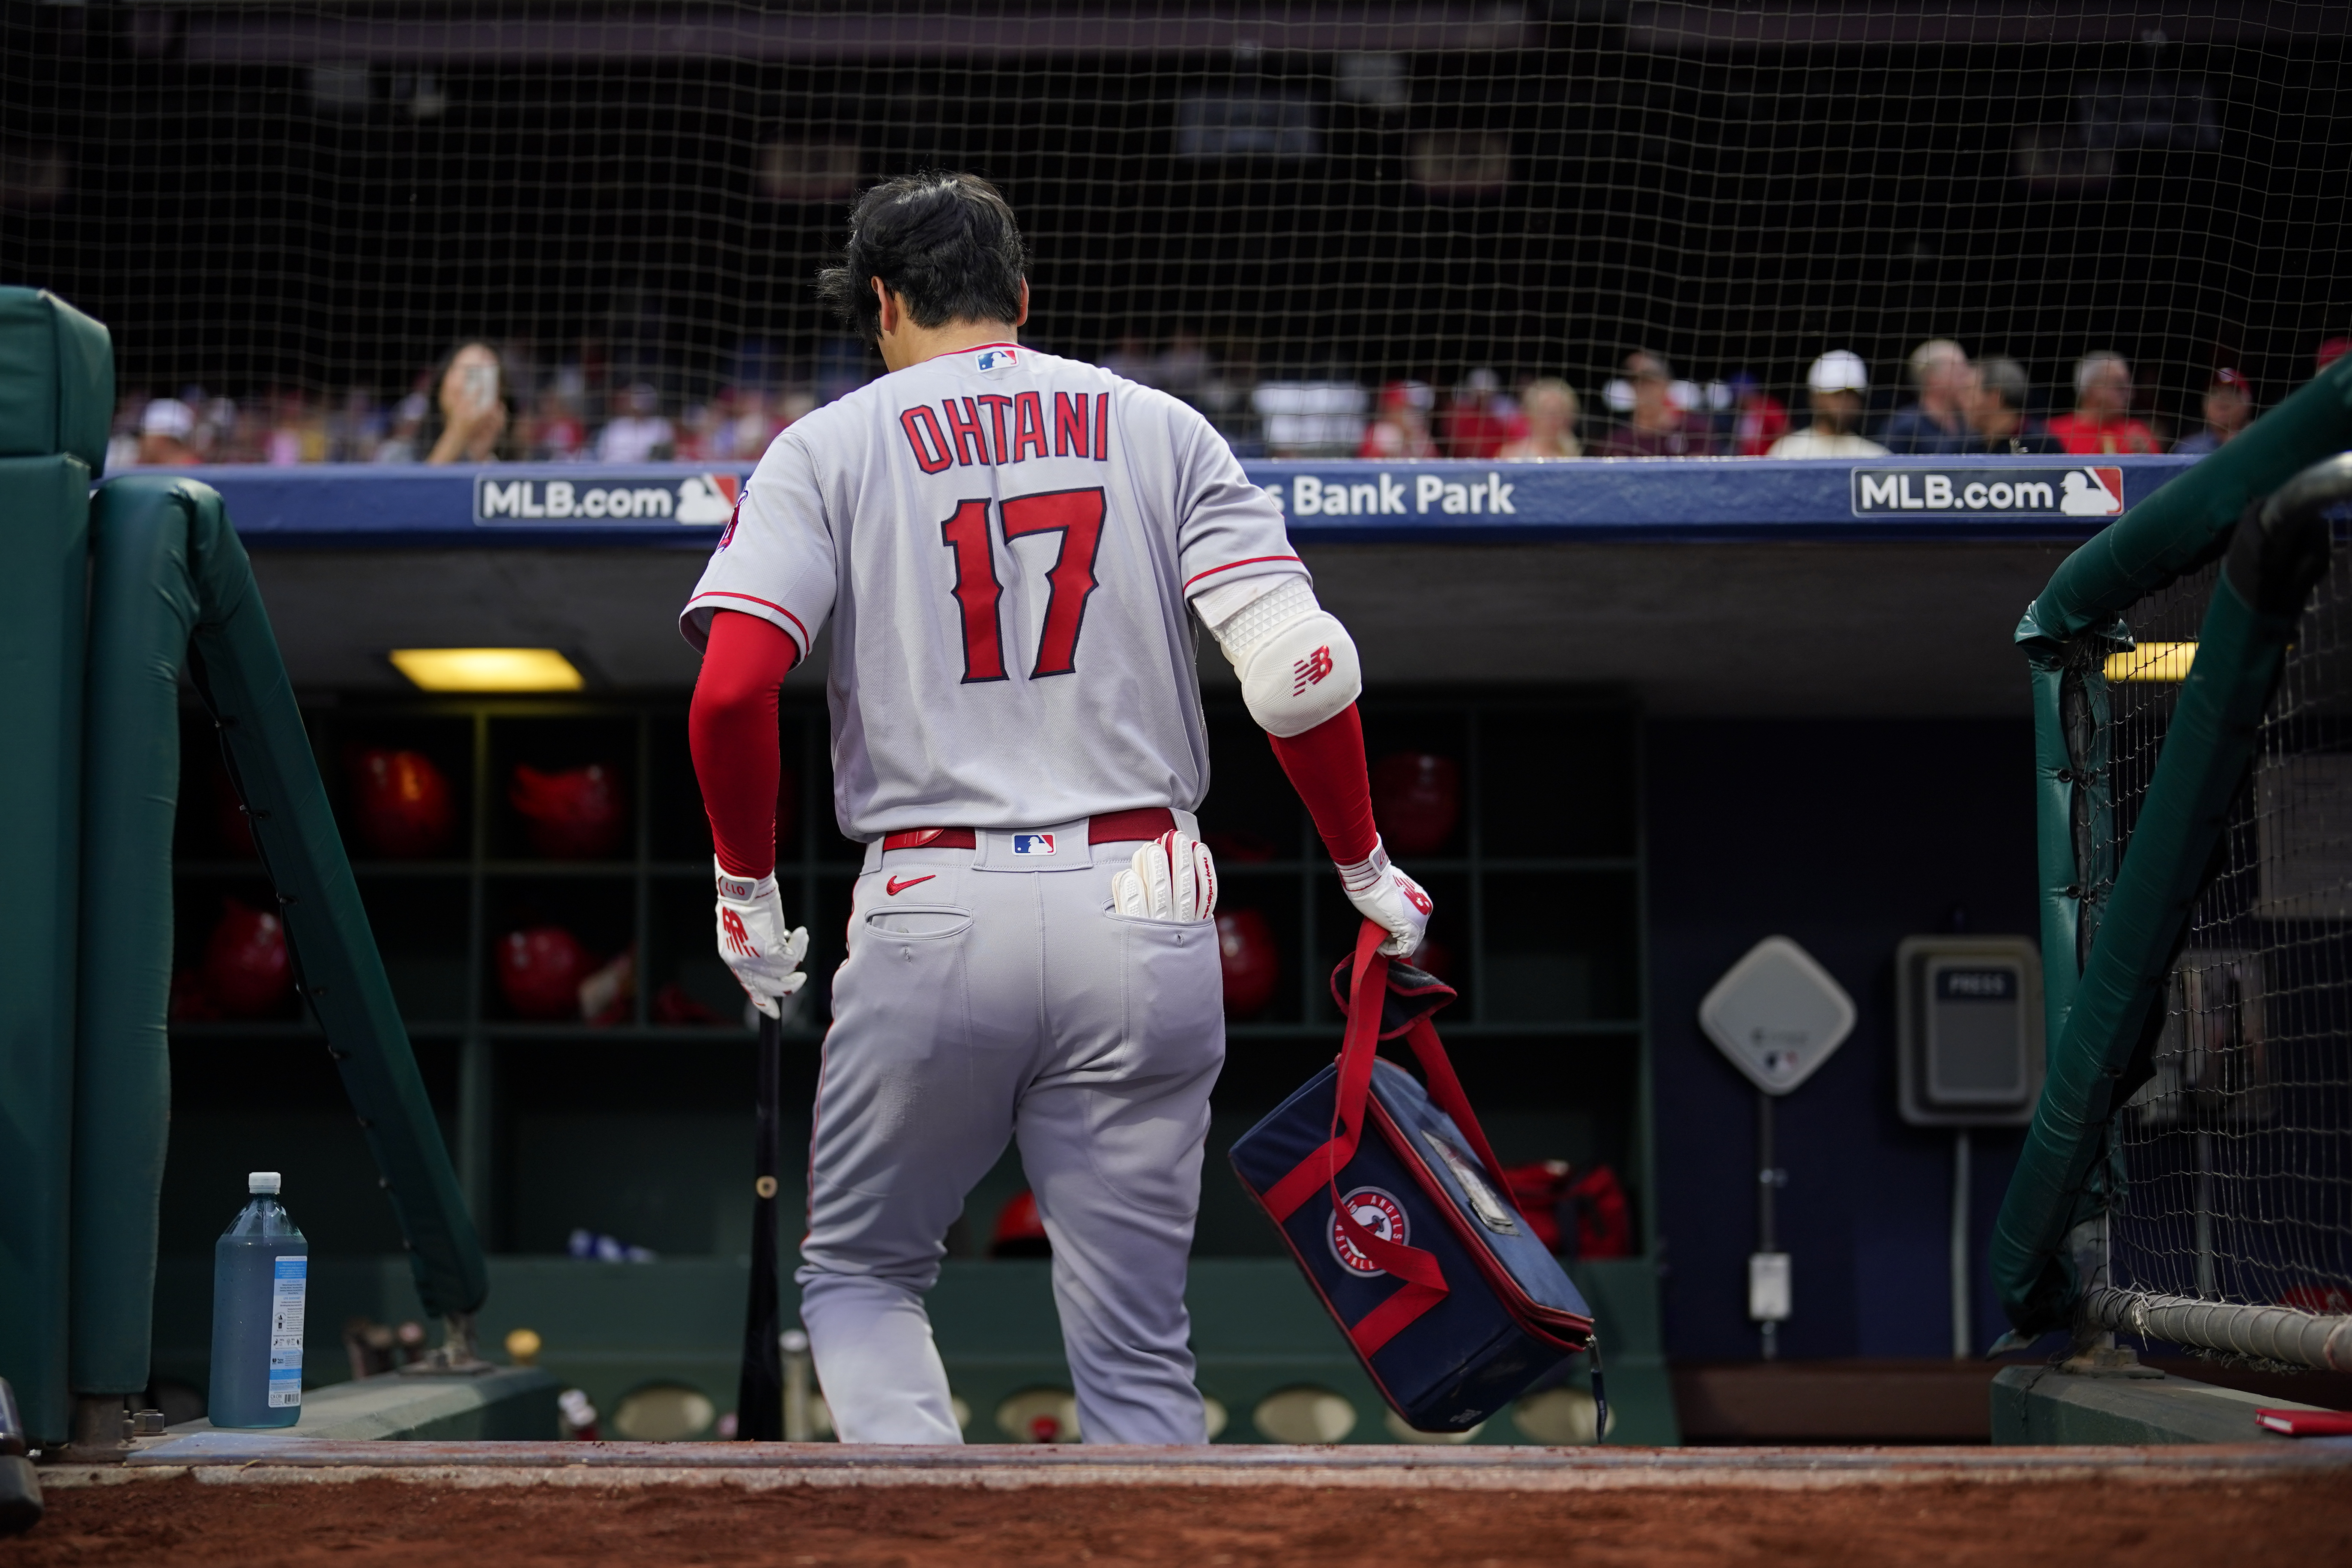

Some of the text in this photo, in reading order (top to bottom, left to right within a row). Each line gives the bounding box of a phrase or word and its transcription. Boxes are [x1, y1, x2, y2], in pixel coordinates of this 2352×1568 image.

[900, 391, 1109, 475] OHTANI
[482, 480, 673, 518] MLB.com
[1293, 472, 1407, 515] Bank
[1416, 472, 1516, 514] Park
[1861, 475, 2054, 509] MLB.com
[941, 486, 1107, 684] 17
[1371, 1195, 1403, 1239] ANGELS
[1335, 1225, 1375, 1269] ASEBALL
